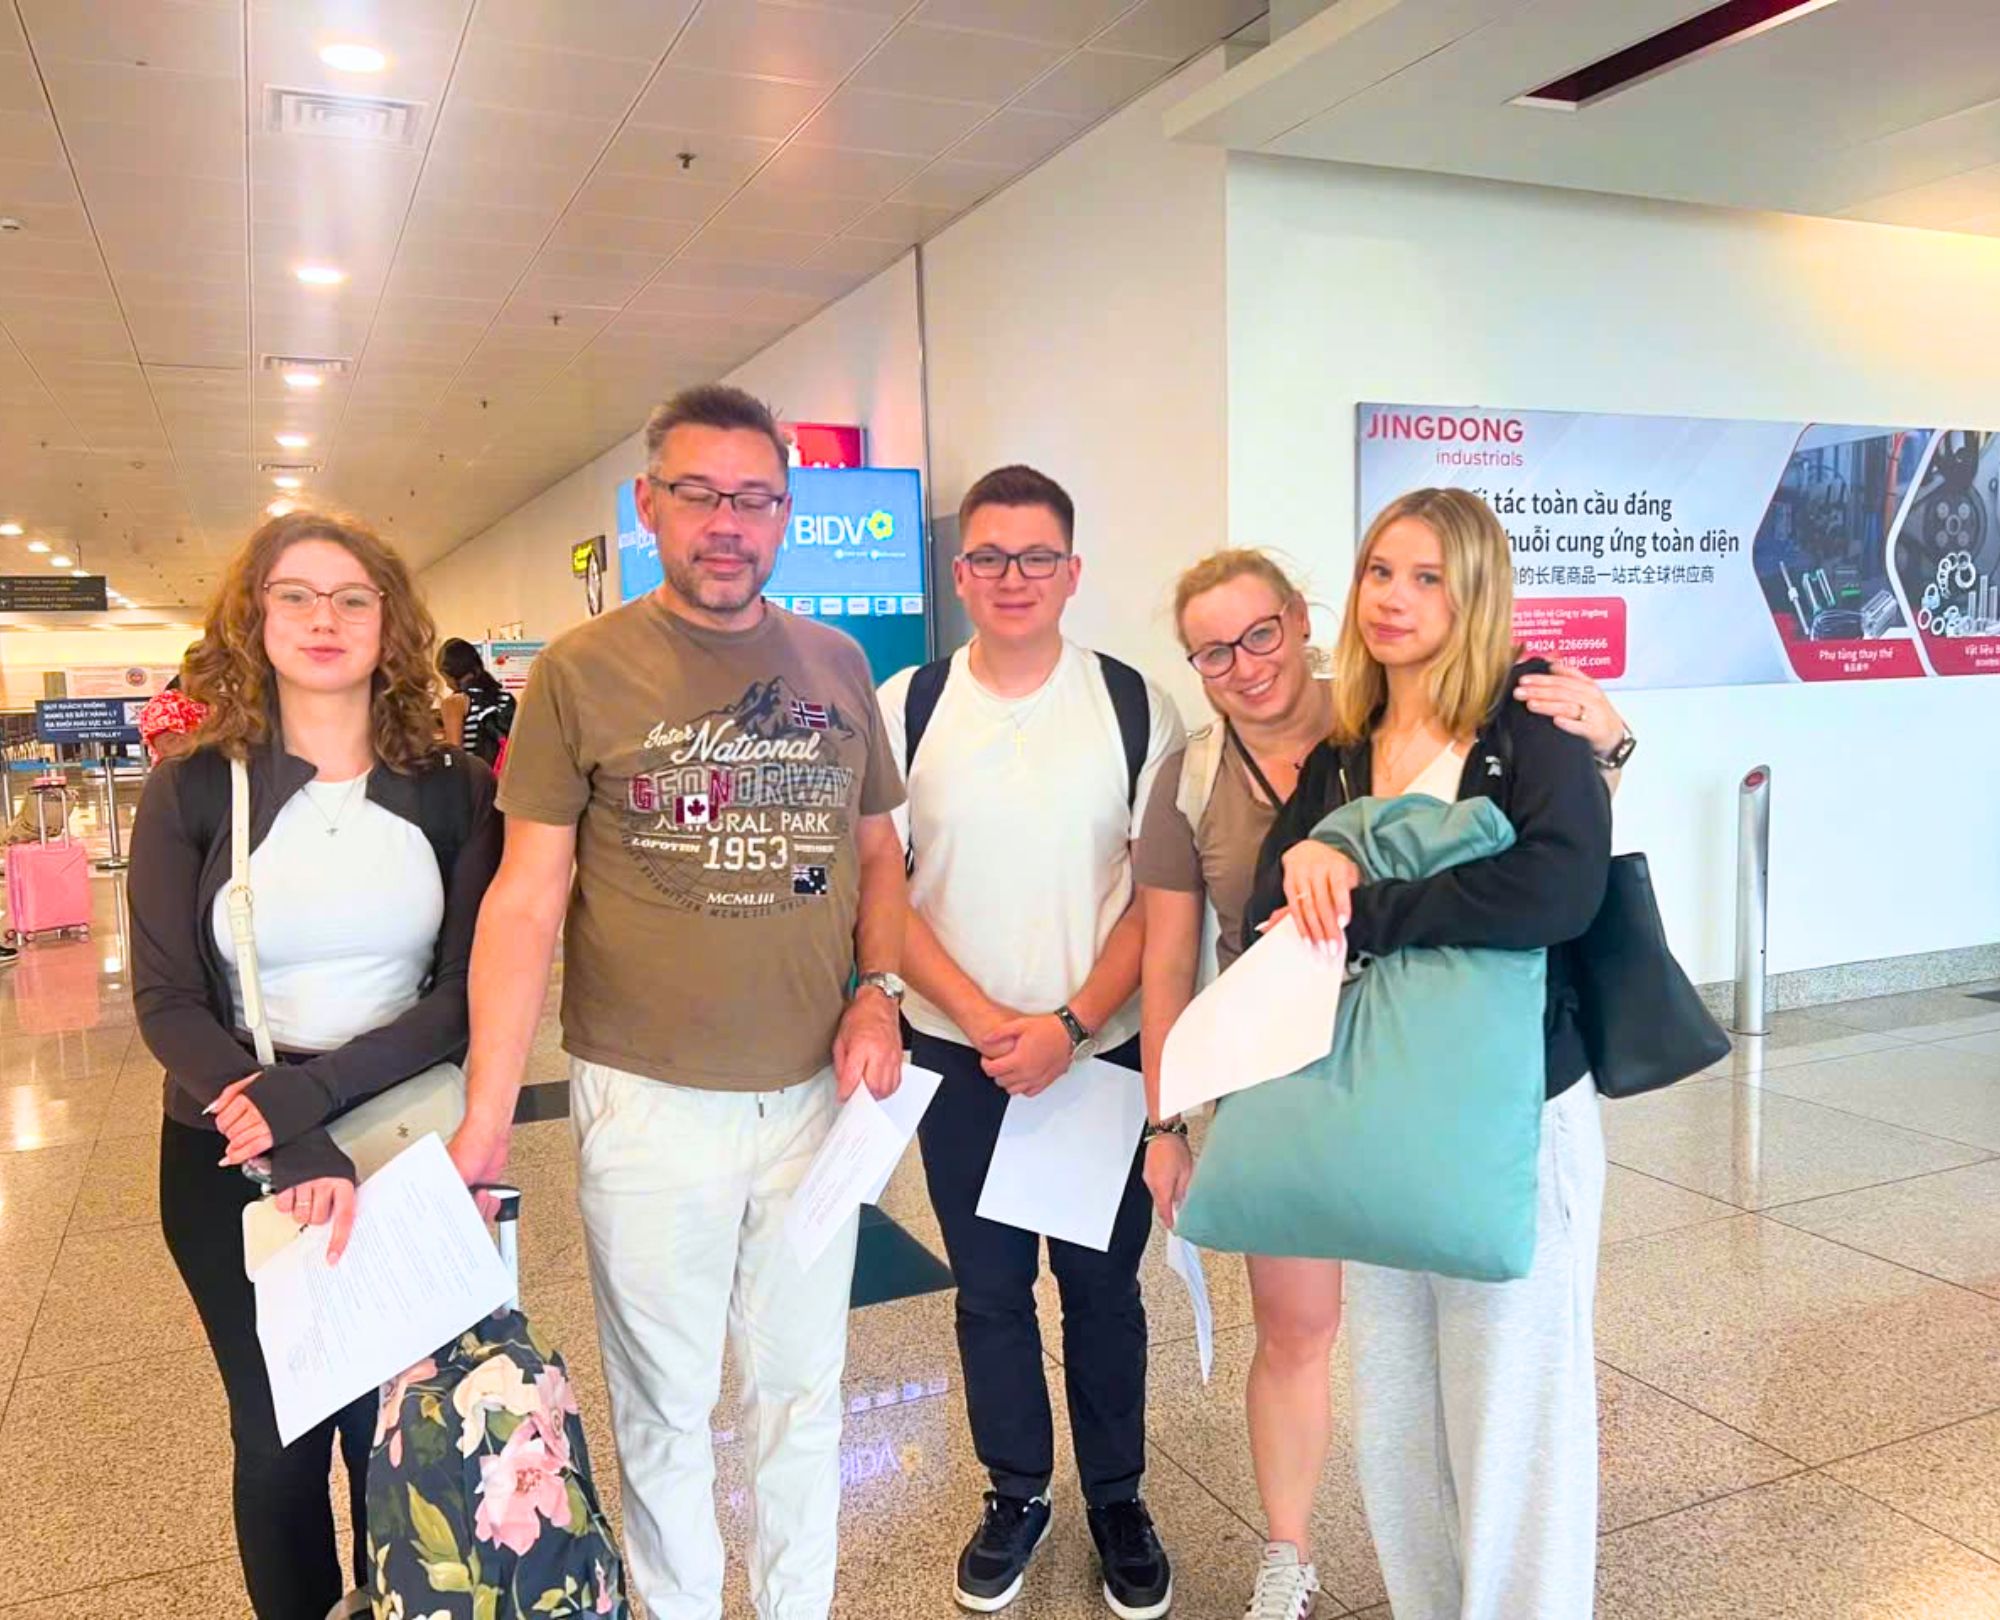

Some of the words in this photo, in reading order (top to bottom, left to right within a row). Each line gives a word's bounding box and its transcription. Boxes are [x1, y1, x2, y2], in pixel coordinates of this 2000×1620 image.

[1367, 414, 1523, 443] JINGDONG
[1436, 449, 1523, 466] industrials
[1494, 487, 1526, 514] tác
[1533, 489, 1578, 515] toàn
[1584, 489, 1618, 515] cầu
[1624, 490, 1672, 522] đáng
[795, 515, 867, 545] BIDV
[1506, 525, 1550, 552] huỗi
[1556, 535, 1604, 558] cung
[1610, 527, 1646, 558] ứng
[1652, 528, 1694, 552] toàn
[1700, 530, 1739, 558] diện
[1525, 640, 1555, 652] 84)24
[1558, 638, 1608, 650] 22669966
[1562, 656, 1611, 668] 1@jd.com
[671, 720, 821, 763] National
[781, 811, 830, 833] PARK
[703, 836, 788, 870] 1953
[706, 892, 775, 905] MCMLIII
